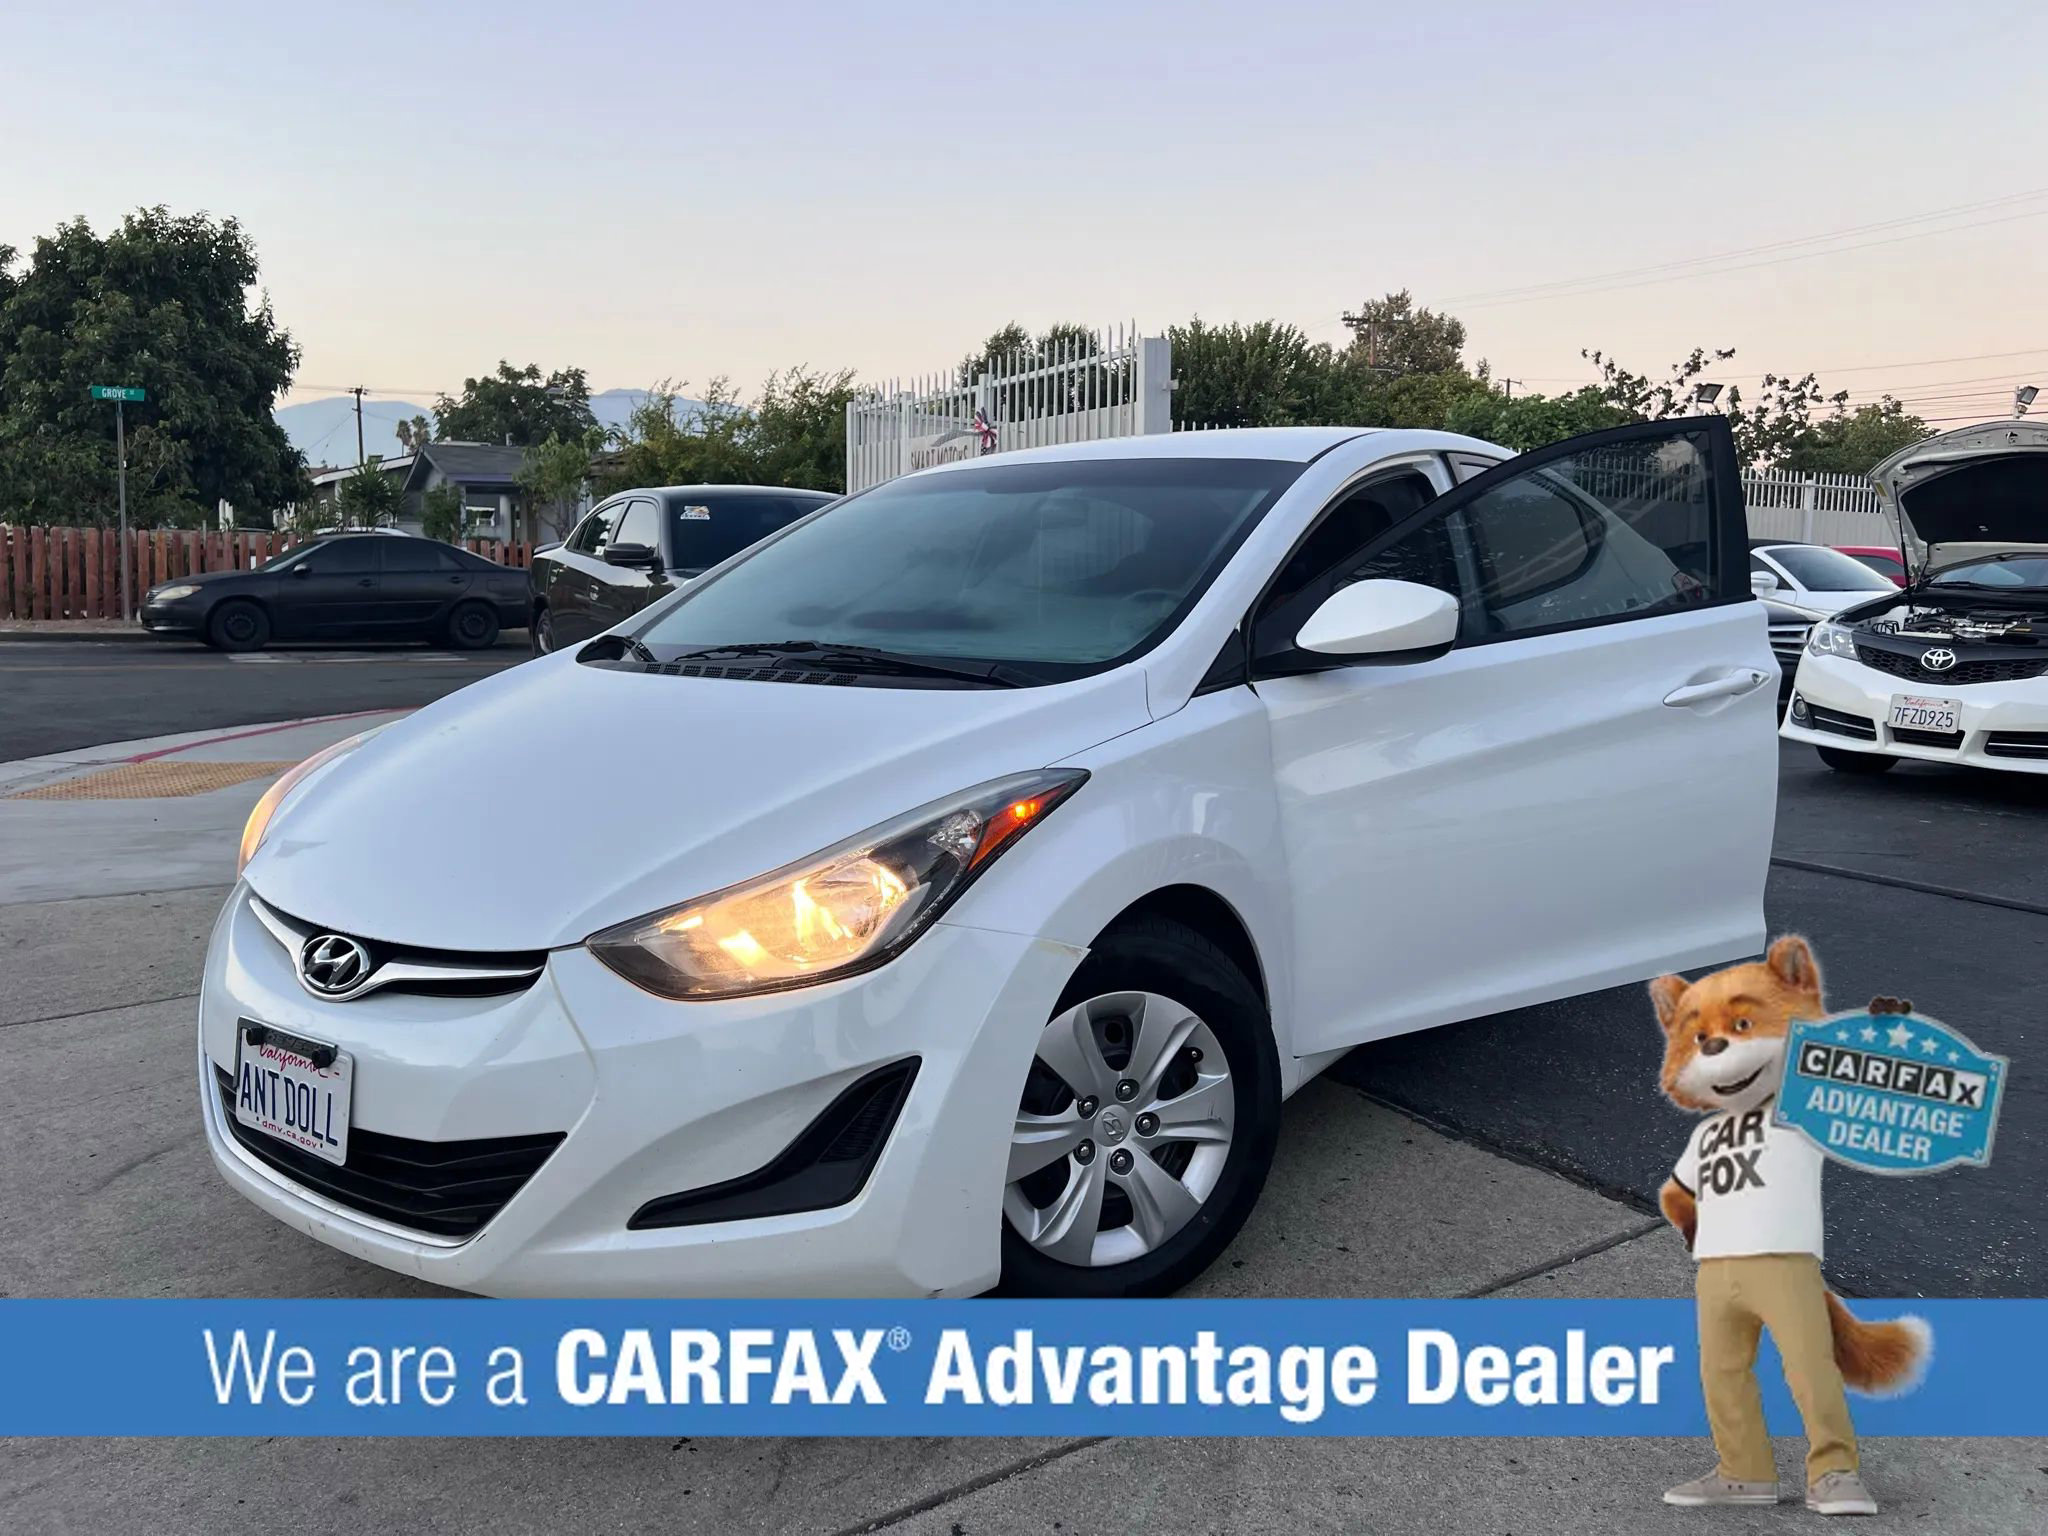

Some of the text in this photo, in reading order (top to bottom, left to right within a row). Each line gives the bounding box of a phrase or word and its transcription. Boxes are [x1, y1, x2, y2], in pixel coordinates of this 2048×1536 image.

[101, 388, 127, 399] GROVE
[911, 448, 936, 470] SMART
[1894, 706, 1954, 728] 7FZD925
[240, 1061, 339, 1147] ANT DOLL
[262, 1120, 318, 1149] dmv.ca.gov
